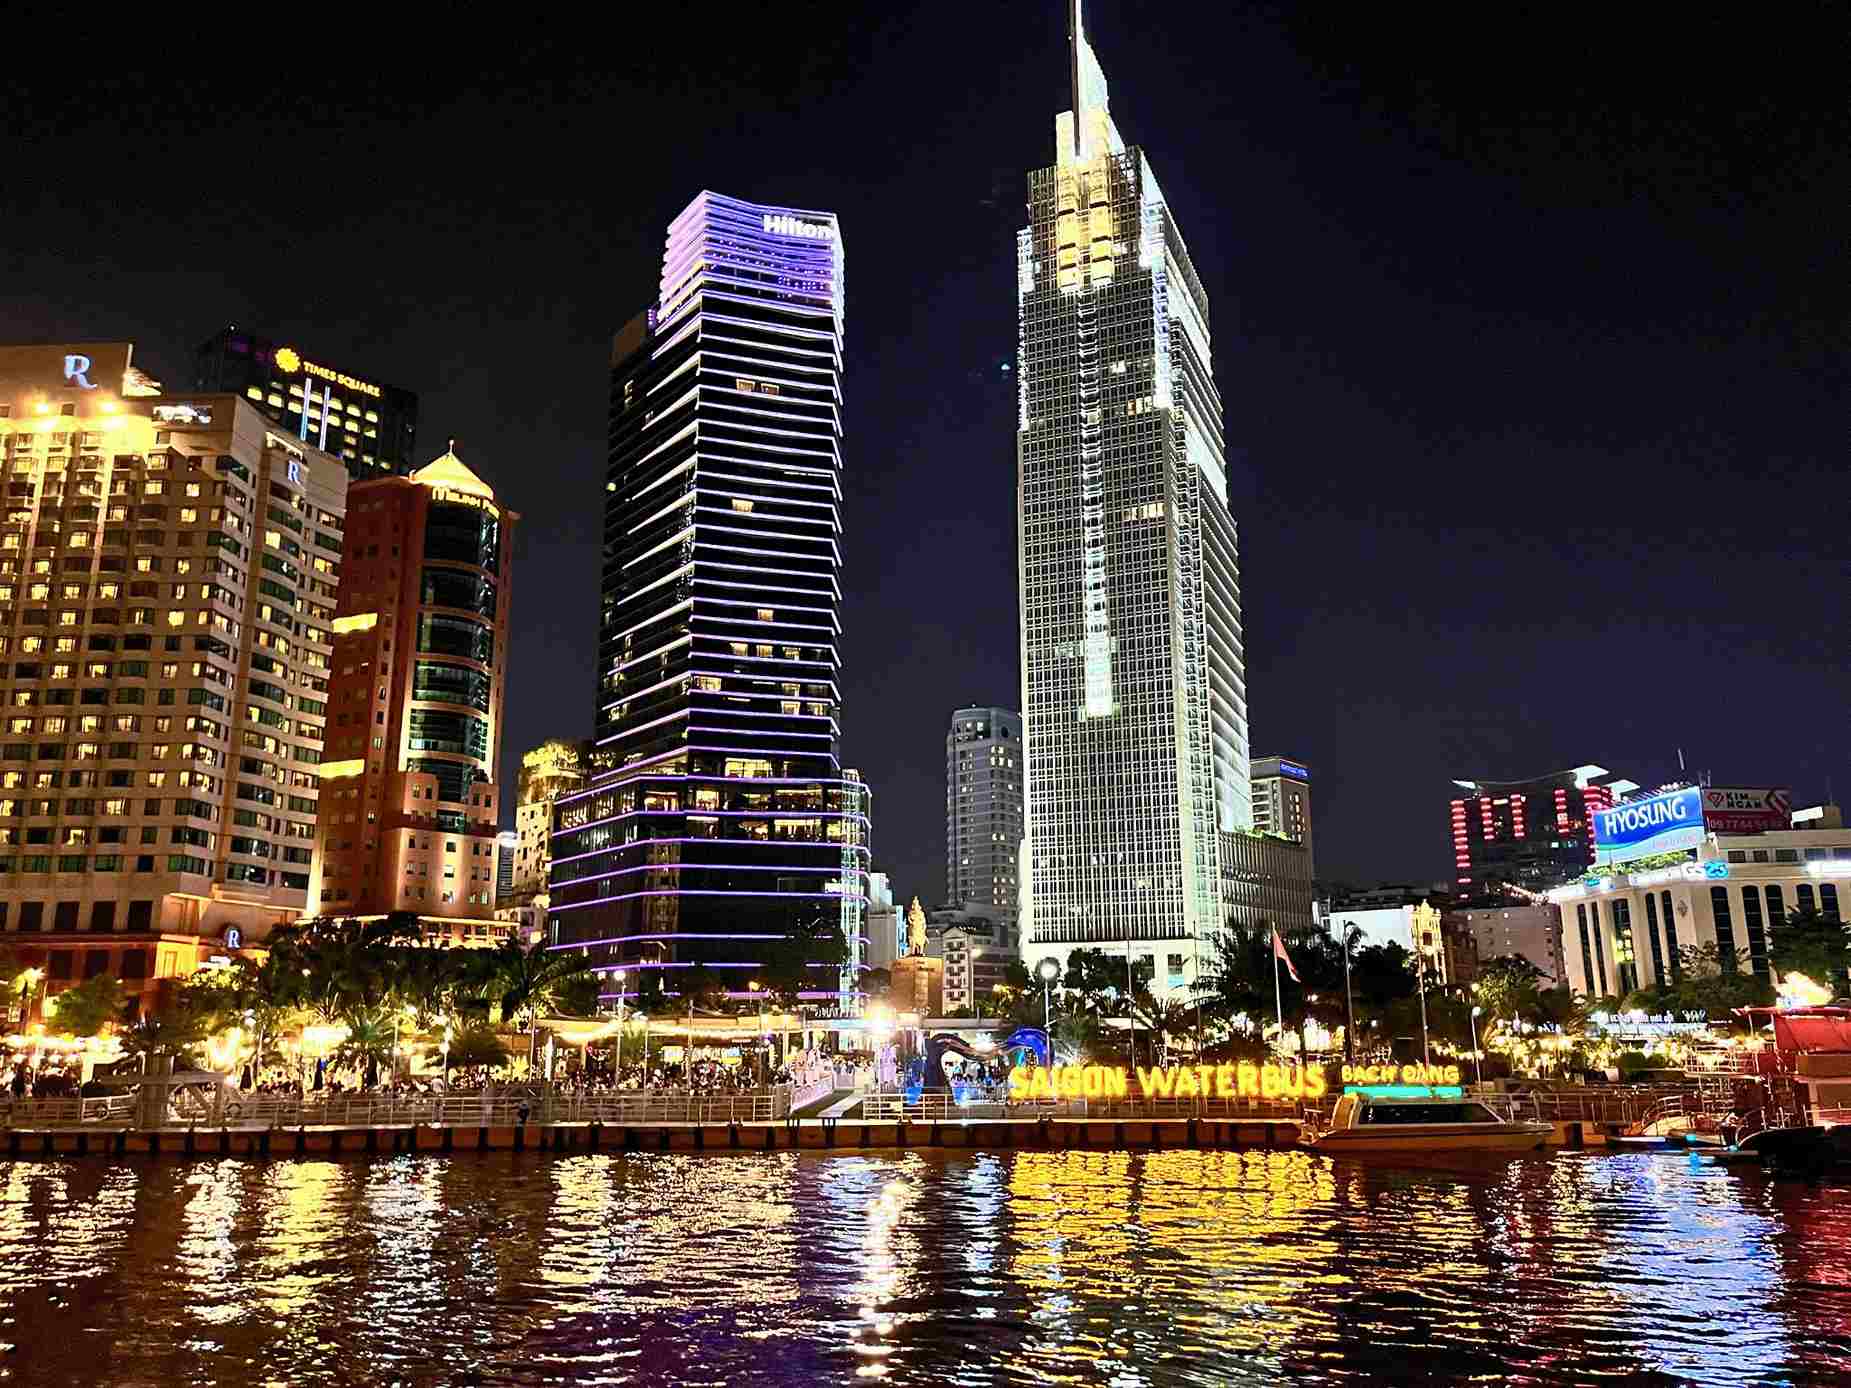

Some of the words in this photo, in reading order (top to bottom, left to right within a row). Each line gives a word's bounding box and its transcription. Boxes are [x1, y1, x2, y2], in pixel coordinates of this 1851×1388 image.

[763, 215, 832, 240] Hilton
[64, 353, 98, 389] R
[303, 361, 336, 381] TIMES
[338, 374, 381, 397] SQUARE
[1604, 797, 1686, 836] HYOSUNG
[1008, 1066, 1127, 1098] SAIGON
[1136, 1066, 1327, 1098] WATERBUS
